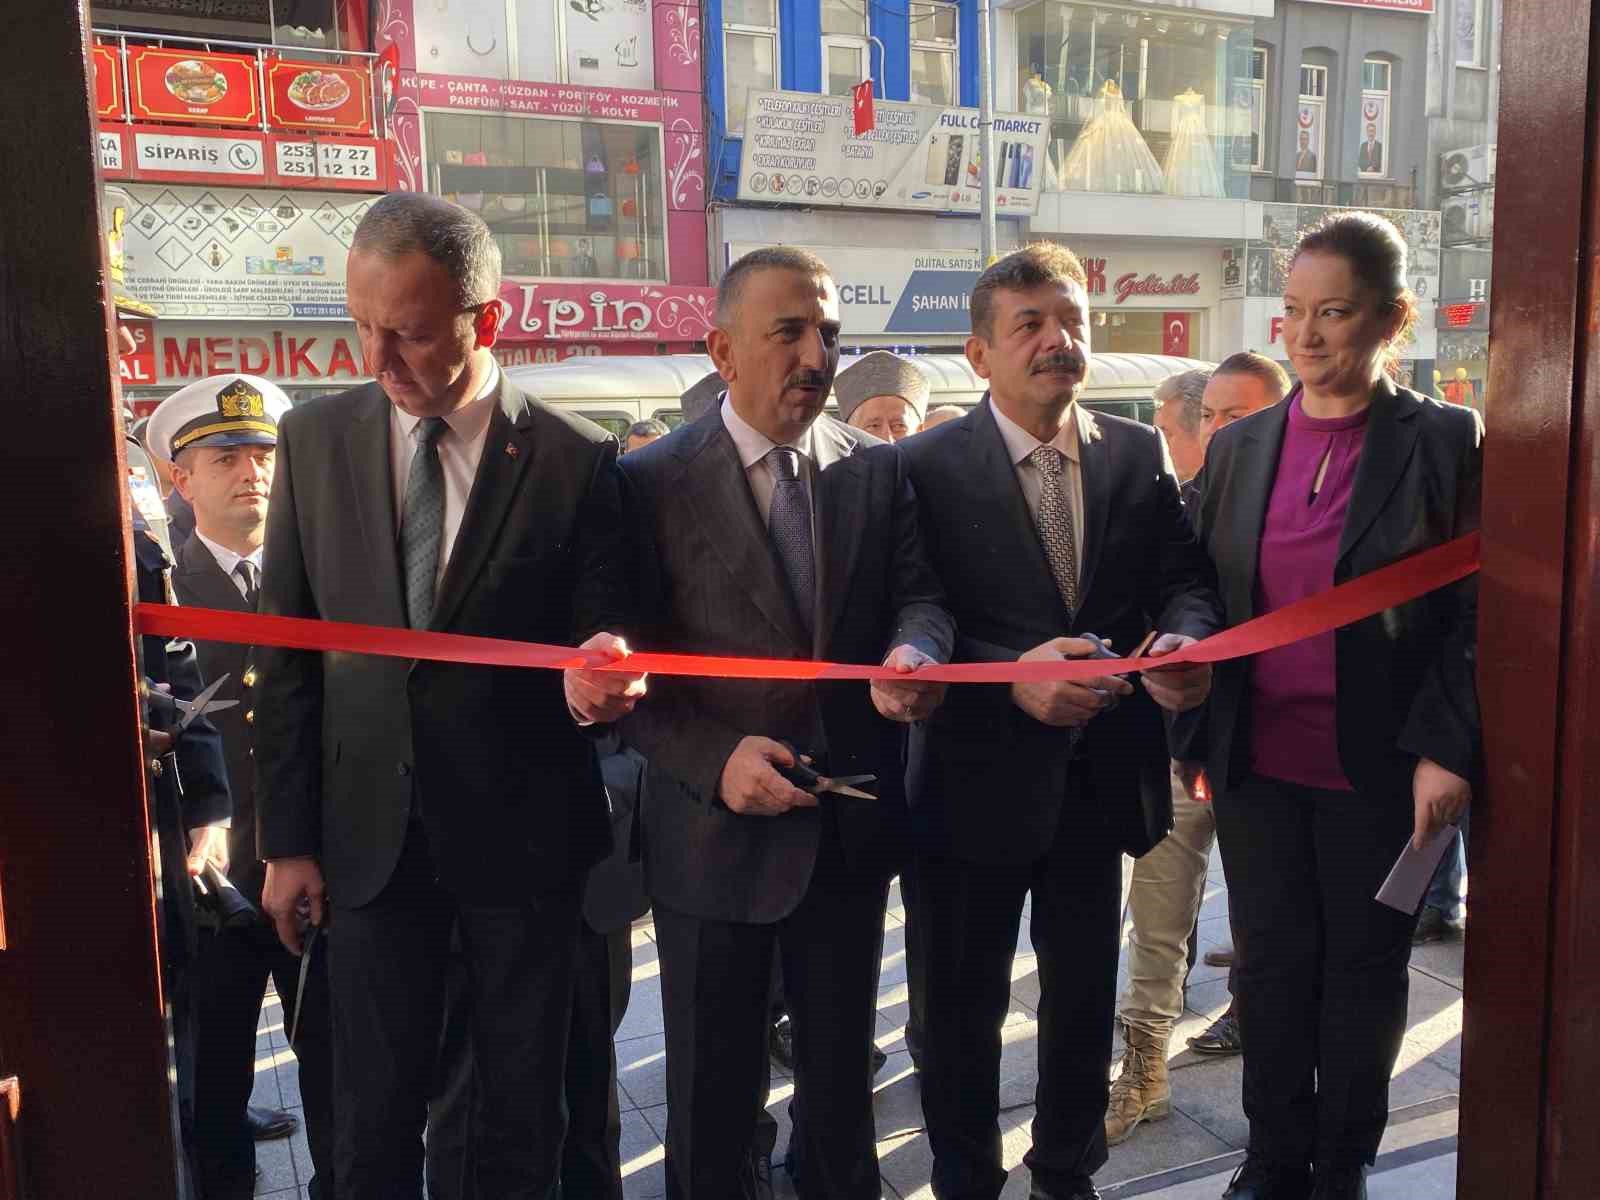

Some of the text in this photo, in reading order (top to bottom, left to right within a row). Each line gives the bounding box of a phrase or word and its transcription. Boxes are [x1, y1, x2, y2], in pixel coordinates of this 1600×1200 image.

[448, 81, 489, 94] ÇANTA
[510, 99, 541, 111] SAAT
[601, 106, 640, 118] KOLYE
[940, 113, 967, 128] FULL
[993, 118, 1041, 134] MARKET
[144, 143, 219, 165] SİPARİŞ
[283, 145, 369, 160] 253 17 27
[284, 161, 370, 176] 251 12 12
[836, 284, 892, 305] CELL
[912, 292, 971, 312] ŞAHAN İL
